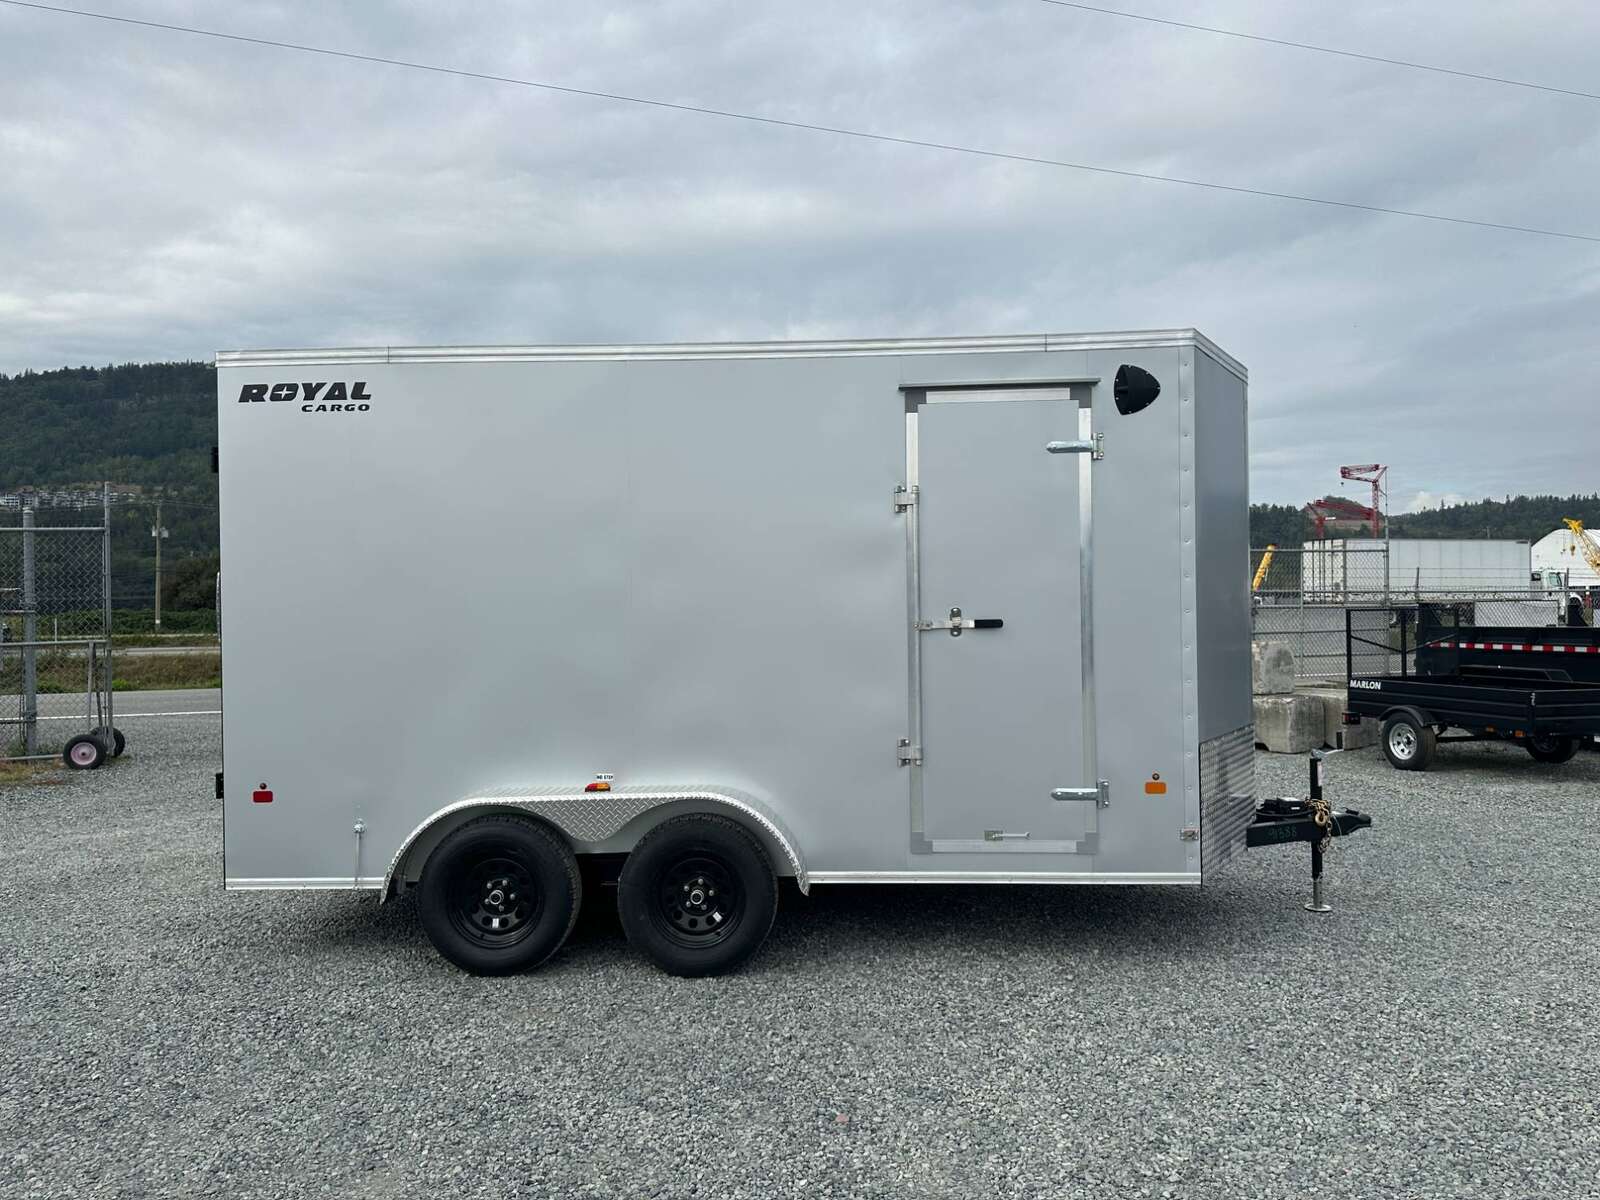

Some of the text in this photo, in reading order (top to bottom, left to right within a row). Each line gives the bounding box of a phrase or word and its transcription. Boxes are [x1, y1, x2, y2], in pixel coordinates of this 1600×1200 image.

[238, 382, 371, 403] ROYAL
[301, 404, 370, 412] CARGO
[1350, 680, 1381, 690] MARLON
